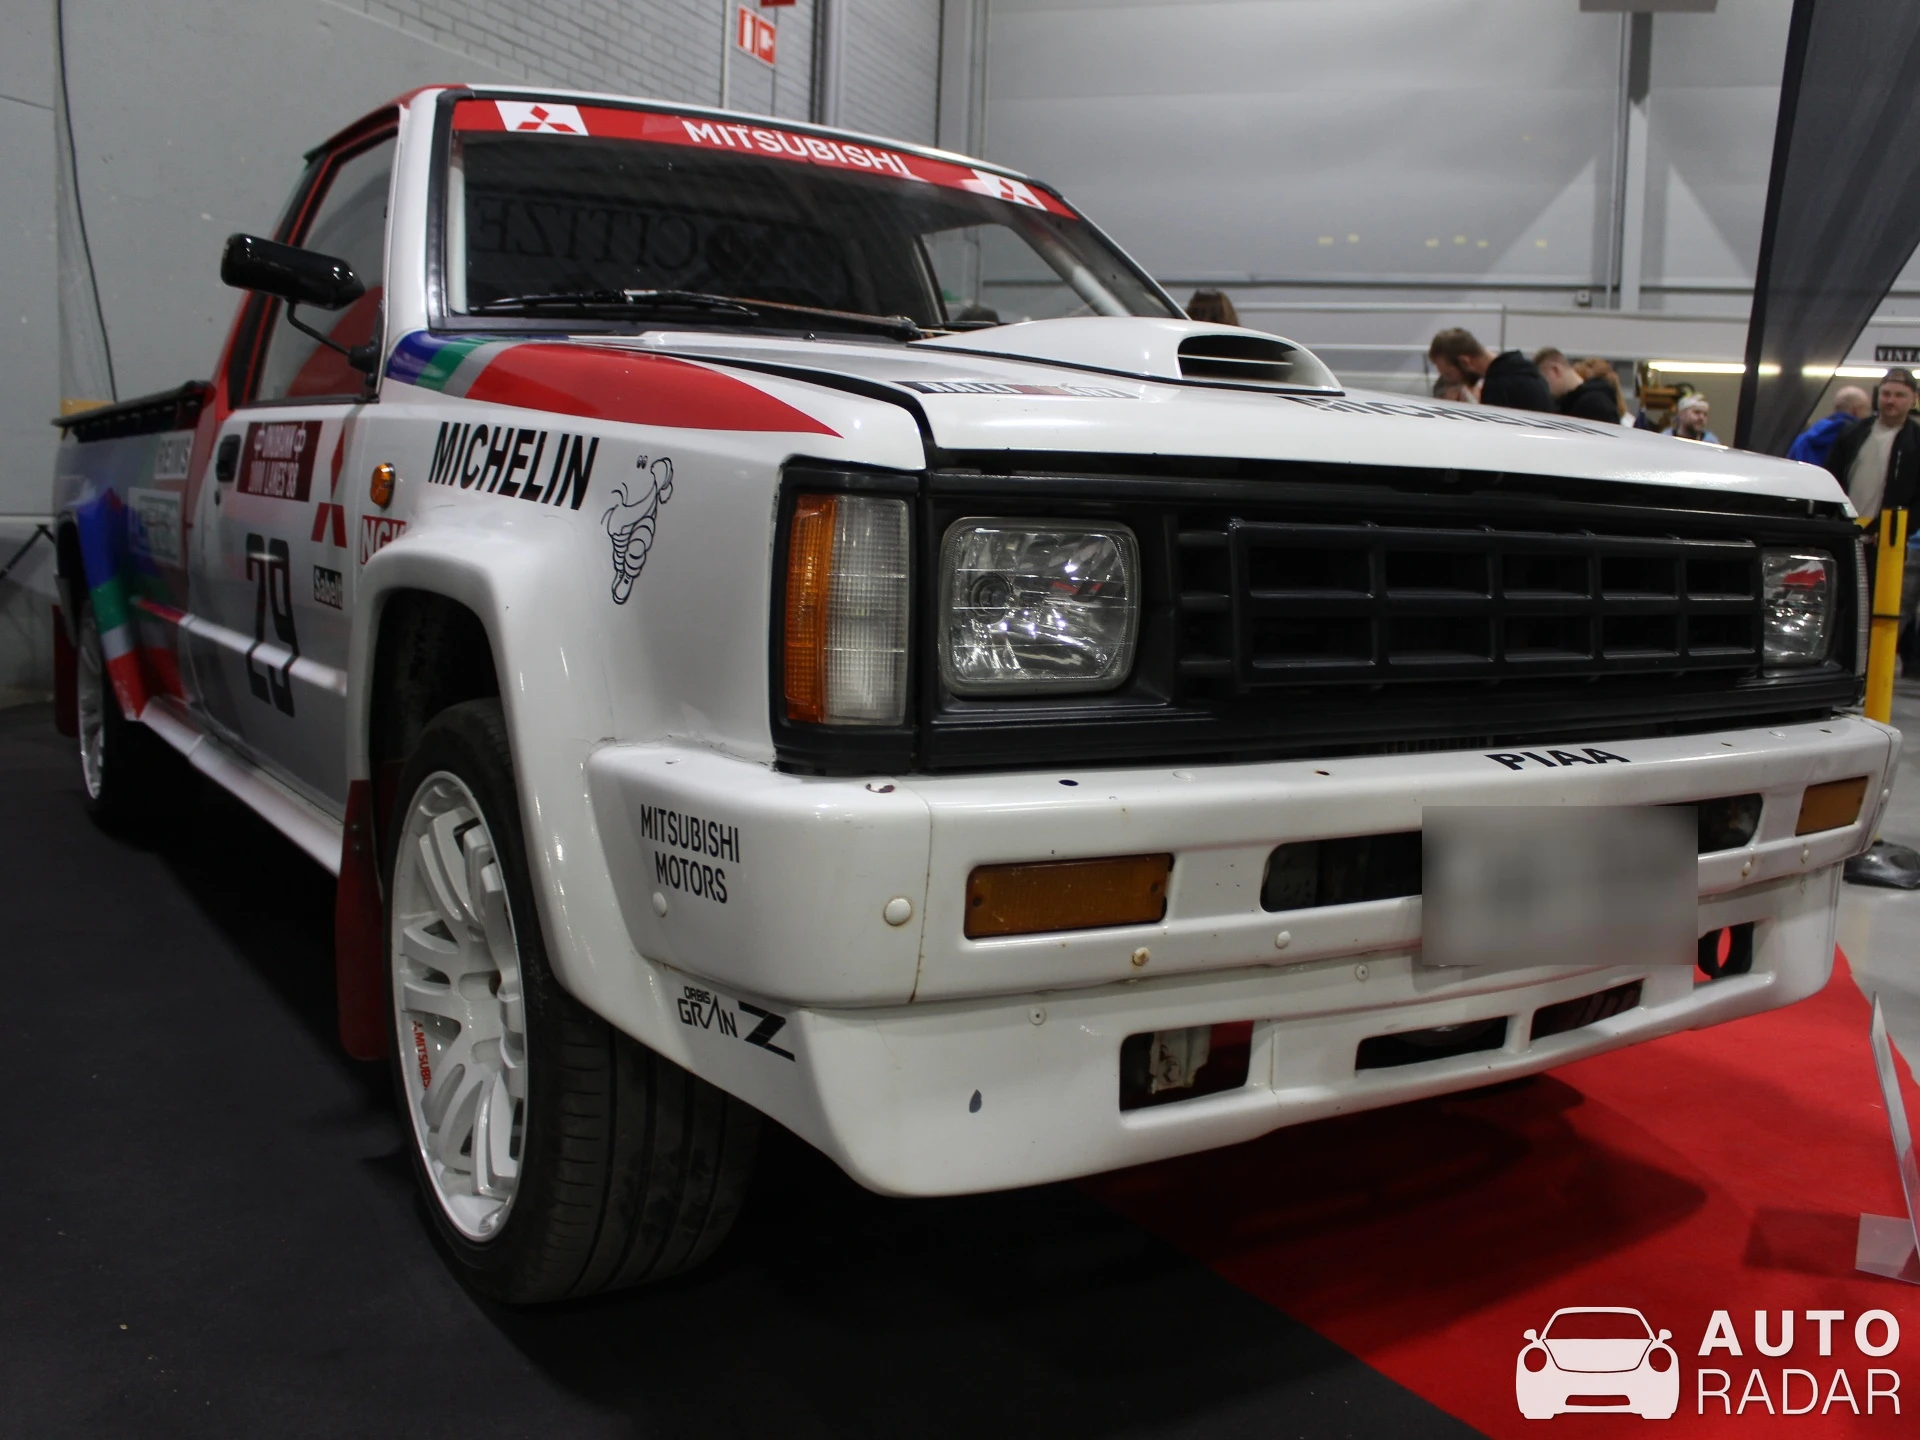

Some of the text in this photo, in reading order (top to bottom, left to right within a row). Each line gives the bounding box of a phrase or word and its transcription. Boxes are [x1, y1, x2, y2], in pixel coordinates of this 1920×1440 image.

[682, 119, 913, 177] MITSUBISHI
[1276, 395, 1621, 438] MICHELIN
[428, 421, 599, 511] MICHELIN
[245, 532, 298, 718] 29
[1484, 748, 1631, 771] PIAA
[640, 803, 740, 864] MITSUBISHI
[654, 850, 728, 904] MOTORS
[683, 985, 711, 1006] ORBIS
